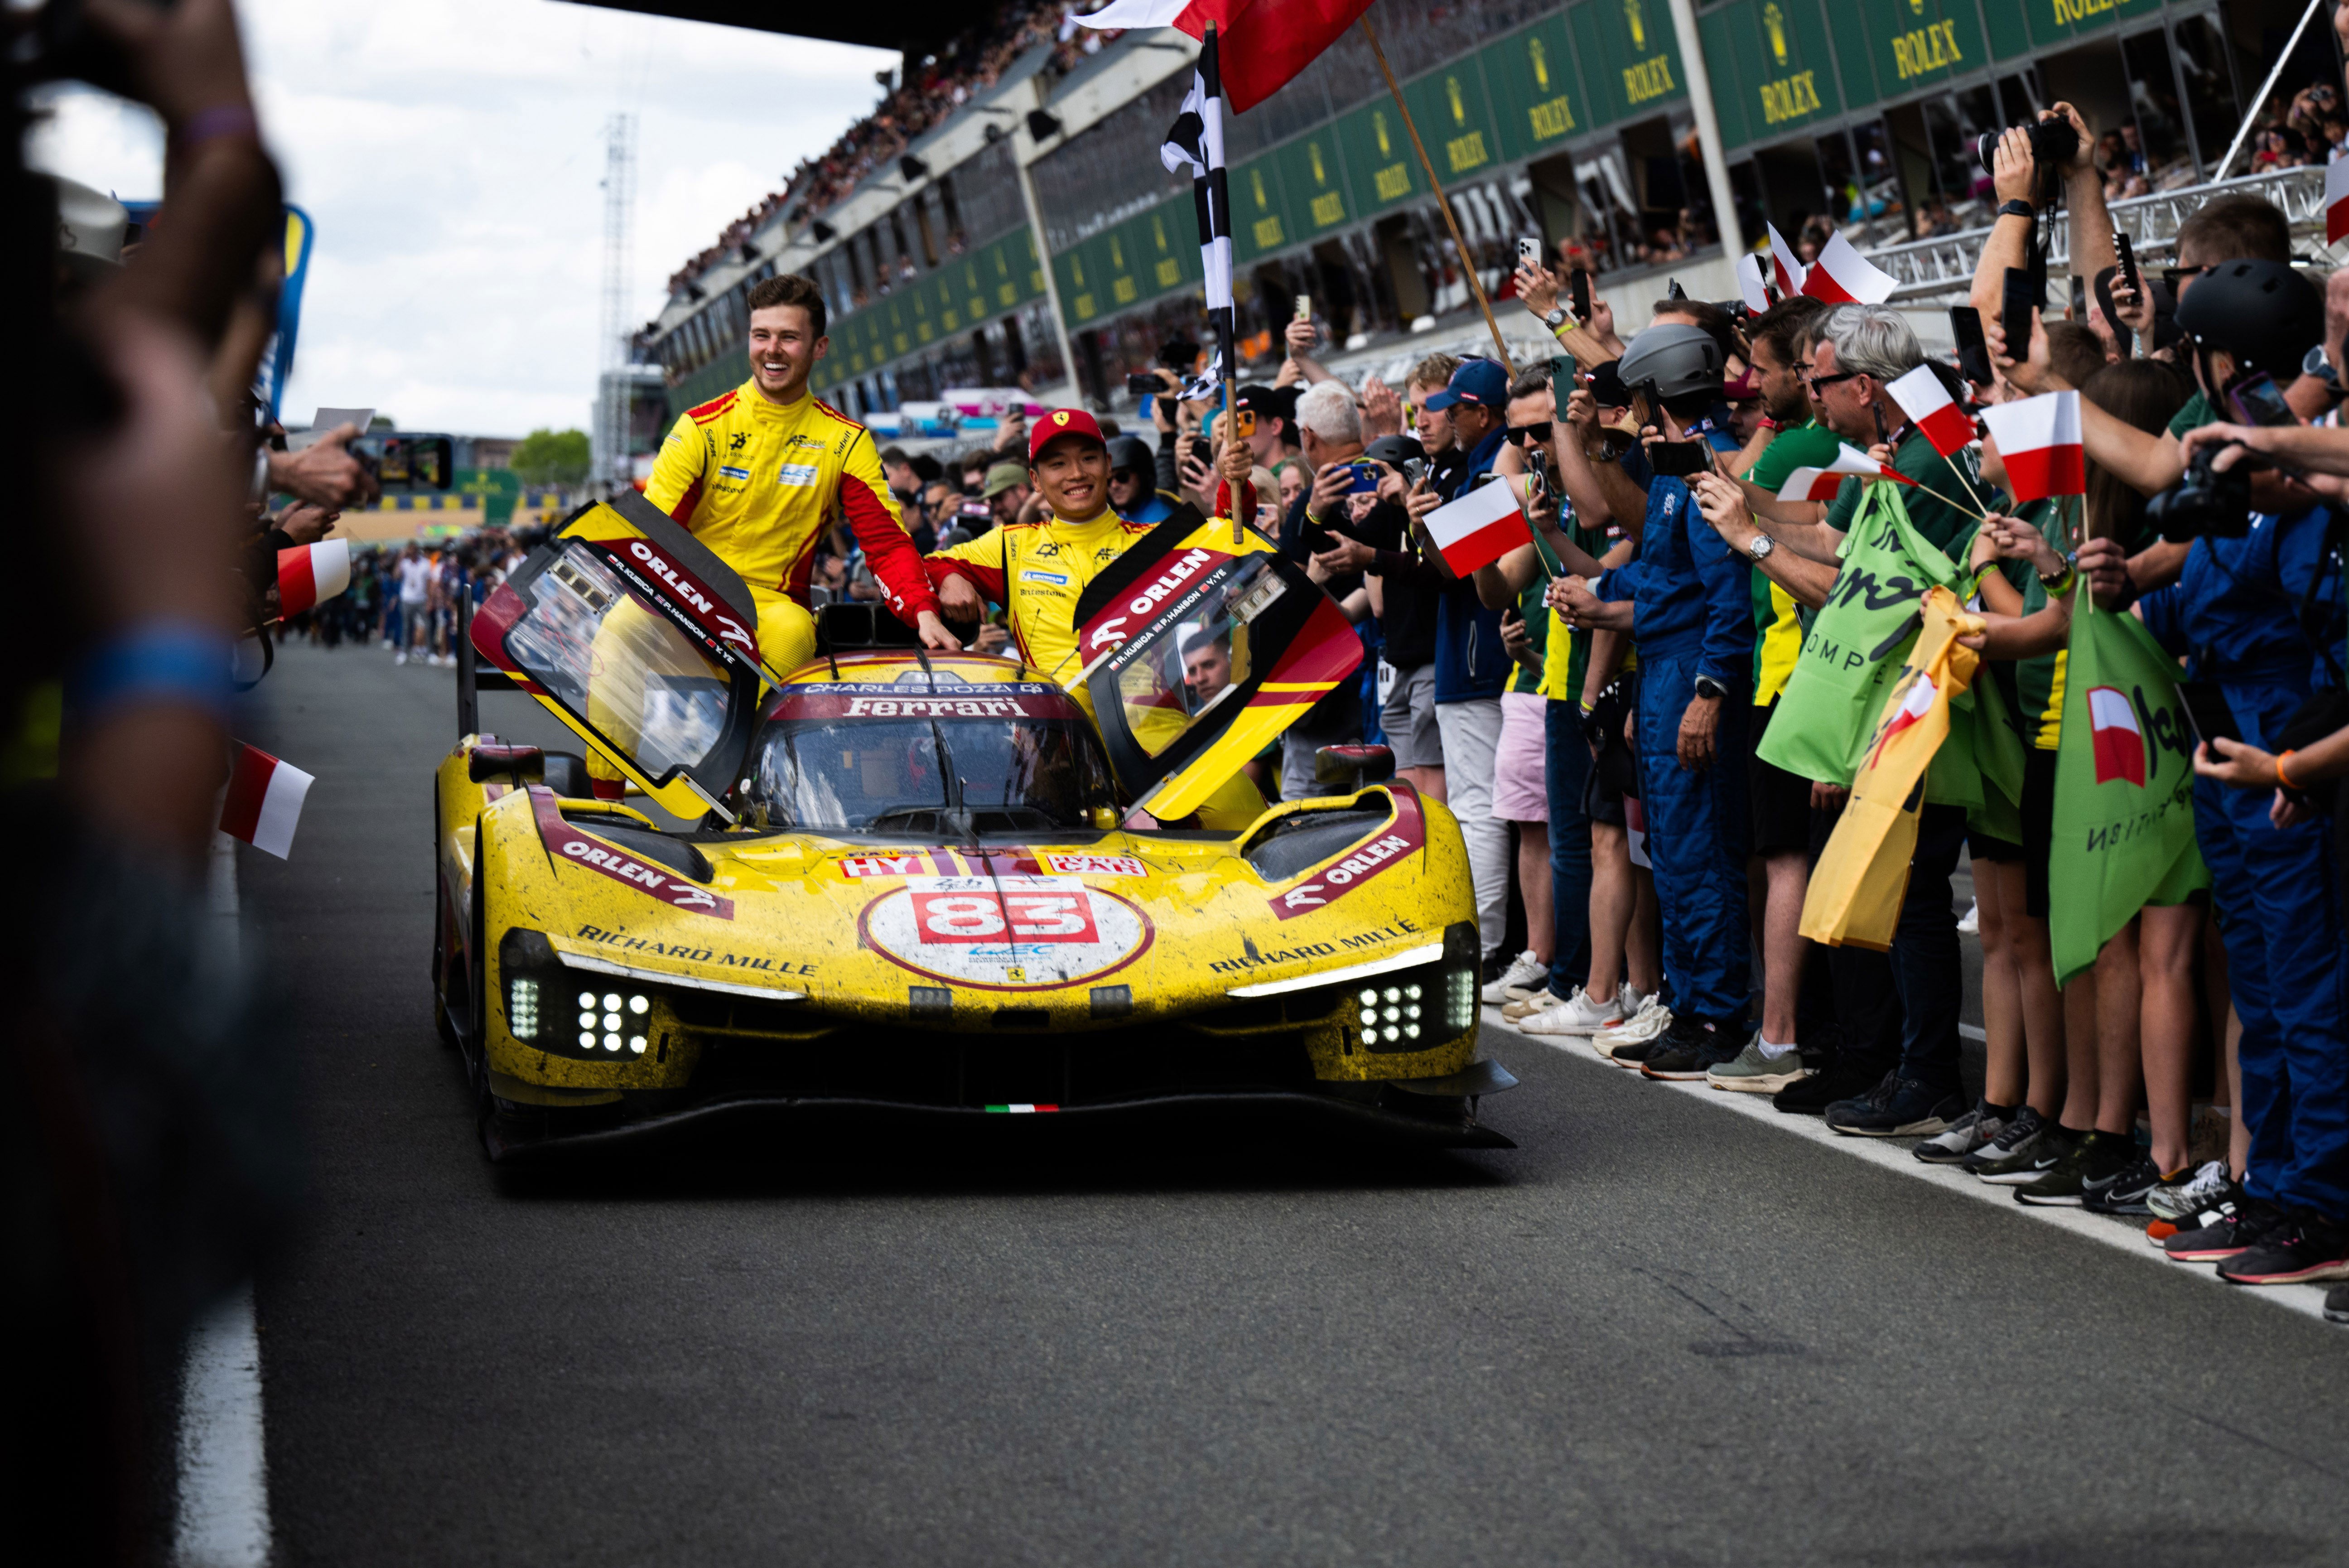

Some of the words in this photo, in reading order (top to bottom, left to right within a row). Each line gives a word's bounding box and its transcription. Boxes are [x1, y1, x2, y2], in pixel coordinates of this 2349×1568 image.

[1891, 18, 1963, 80] ROLEX
[1623, 54, 1675, 104] ROLEX
[1759, 69, 1822, 125] ROLEX
[1529, 96, 1576, 140] ROLEX
[834, 430, 852, 458] Sabelt
[630, 542, 714, 614] ORLEN
[1129, 547, 1211, 615] ORLEN
[804, 683, 929, 694] CHARLES
[936, 684, 1013, 694] POZZI
[842, 696, 1030, 717] Ferrari
[563, 840, 666, 888] ORLEN
[842, 857, 912, 877] HY
[1057, 862, 1141, 875] CAR
[1326, 835, 1411, 885] ORLEN
[926, 896, 1086, 936] 83
[577, 924, 713, 962] RICHARD
[718, 954, 819, 977] MILLE
[969, 944, 1056, 955] WEC
[1209, 943, 1336, 974] RICHARD
[1341, 919, 1421, 949] MILLE
